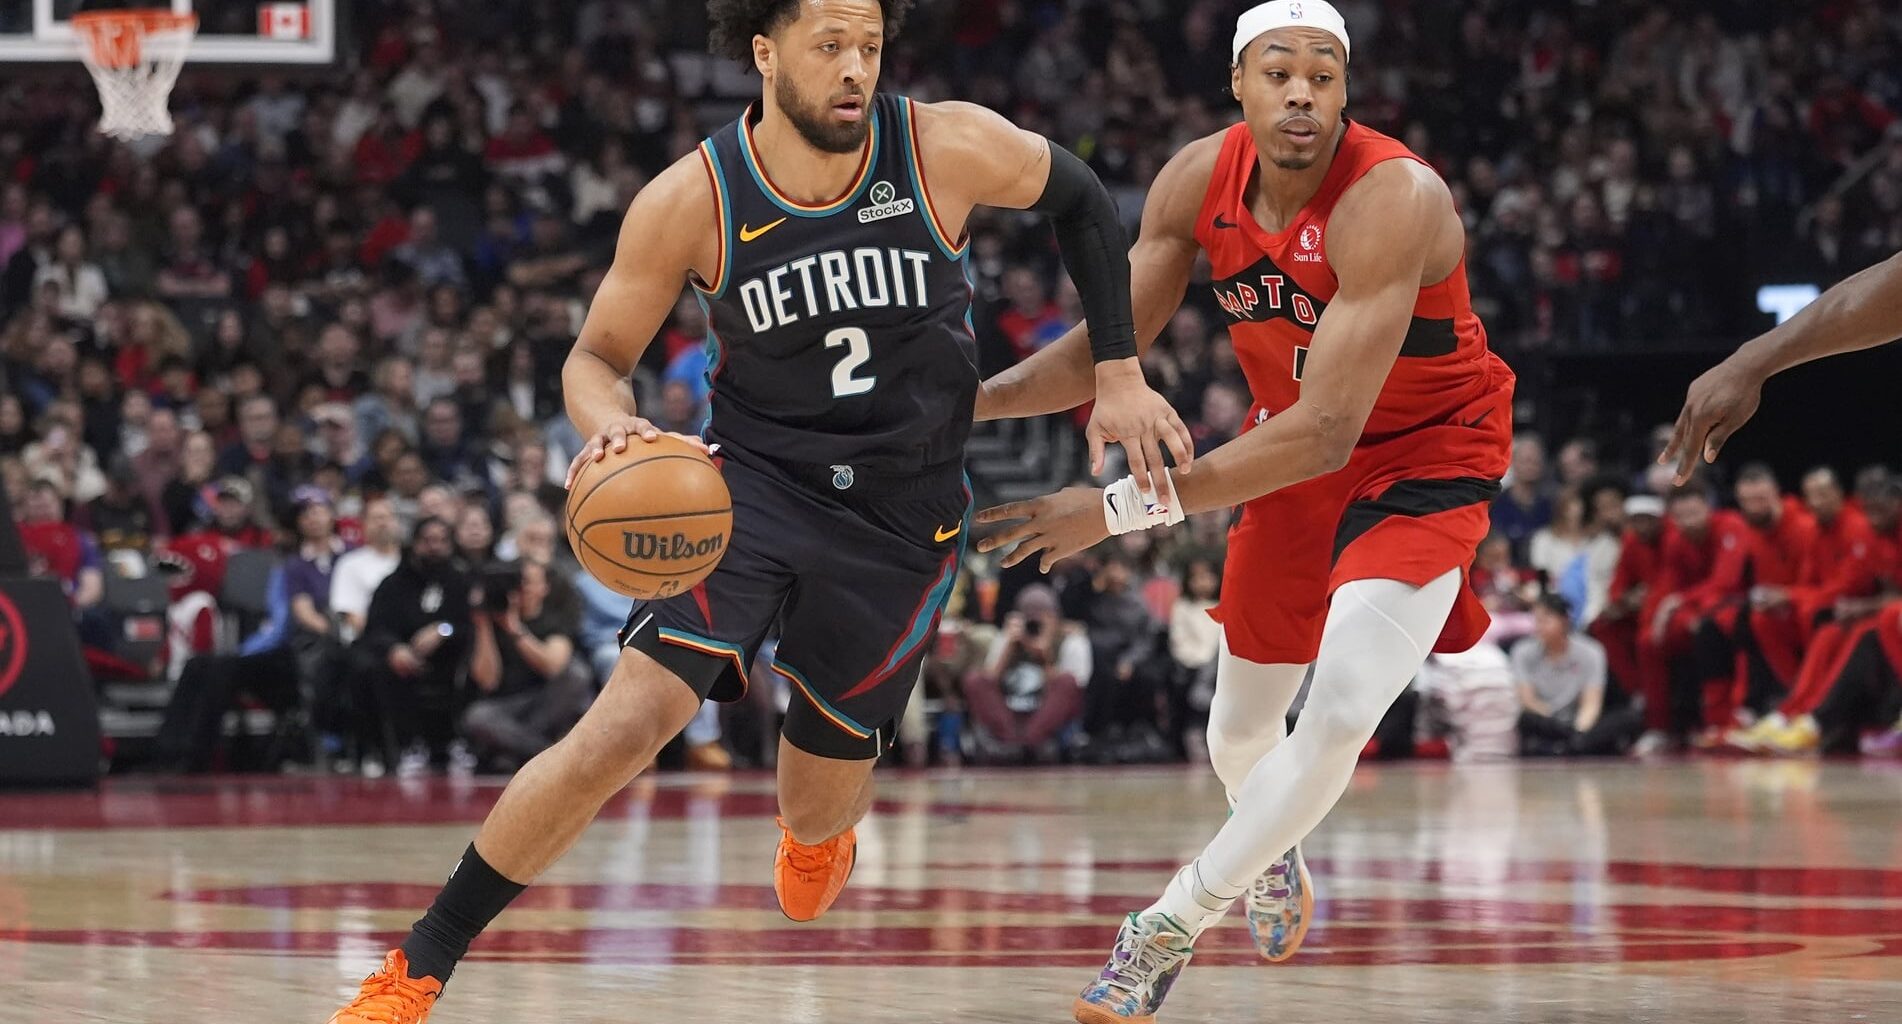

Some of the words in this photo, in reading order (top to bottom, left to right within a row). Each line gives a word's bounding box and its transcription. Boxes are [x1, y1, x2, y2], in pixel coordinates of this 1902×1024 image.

[860, 200, 912, 221] StockX
[1293, 252, 1309, 262] Sun
[1309, 252, 1323, 263] Life
[739, 247, 930, 333] DETROIT
[824, 327, 877, 398] 2
[623, 531, 723, 560] Wilson
